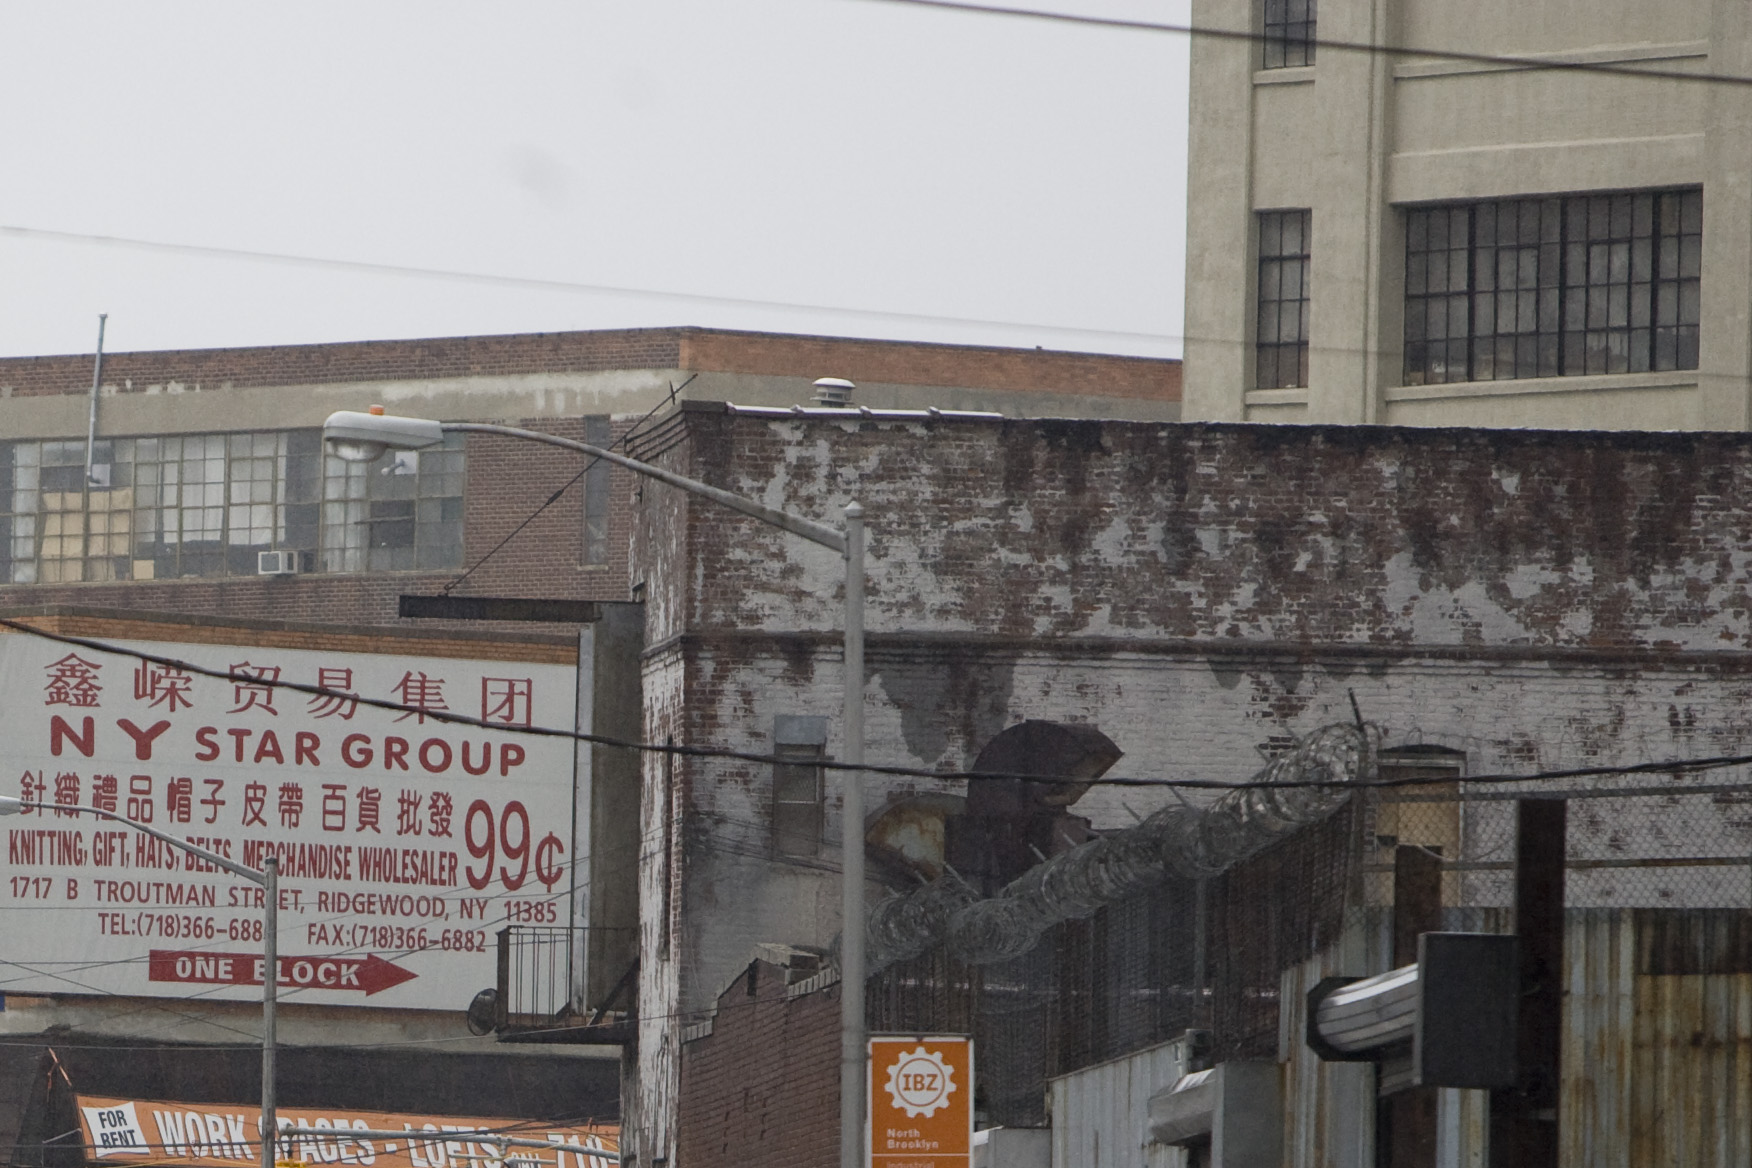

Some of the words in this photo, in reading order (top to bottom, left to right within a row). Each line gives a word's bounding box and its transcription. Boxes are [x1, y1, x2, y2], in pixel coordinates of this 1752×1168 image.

[50, 714, 172, 761] NY
[194, 725, 321, 767] STAR
[340, 732, 526, 778] GROUP
[9, 829, 88, 866] KNITTING,
[92, 831, 130, 868] GIFT,
[135, 834, 180, 872] HATS,
[358, 845, 459, 888] WHOLESALER
[464, 800, 565, 894] 99¢
[9, 876, 53, 900] 1717
[66, 878, 79, 900] B
[93, 879, 216, 908] TROUTMAN
[228, 885, 305, 915] STRET,
[317, 888, 450, 921] RIDGEWOOD,
[459, 897, 489, 920] NY
[503, 900, 558, 924] 11385
[98, 911, 266, 943] TEL:(718)366-688
[174, 955, 234, 981] ONE
[253, 958, 361, 987] BLOCK
[902, 1073, 939, 1092] IBZ
[98, 1109, 128, 1130] FOR
[152, 1109, 255, 1161] WORK
[886, 1128, 921, 1138] North
[100, 1129, 137, 1150] RENT
[886, 1139, 939, 1151] Brooklyn
